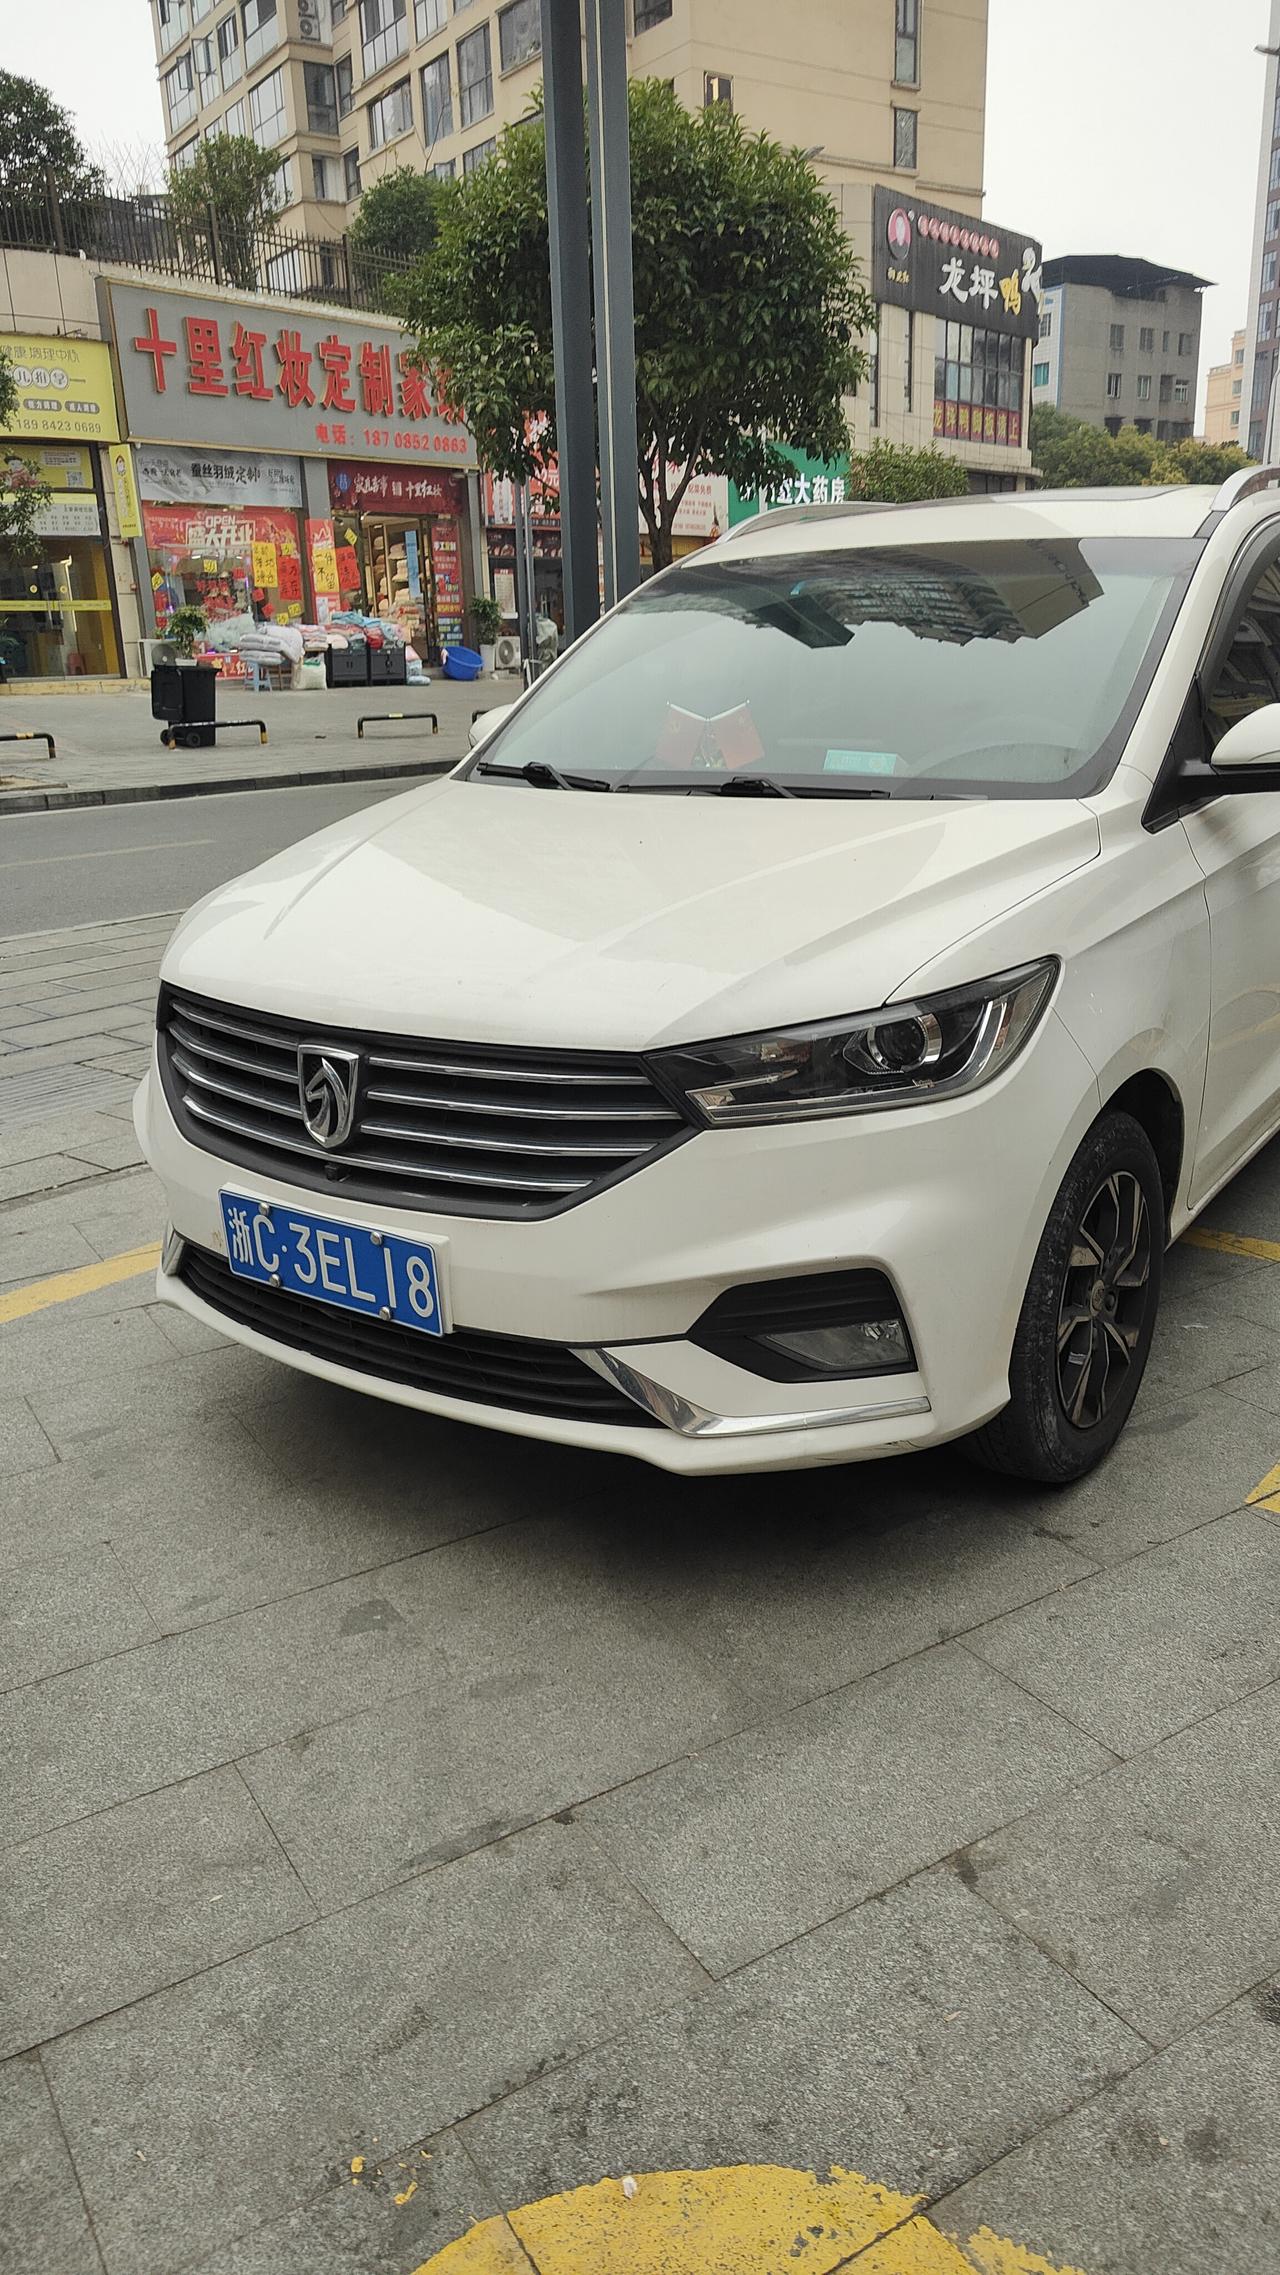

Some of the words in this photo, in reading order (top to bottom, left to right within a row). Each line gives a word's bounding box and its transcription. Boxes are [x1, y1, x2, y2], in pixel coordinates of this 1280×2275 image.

[42, 420, 72, 432] 8423
[74, 422, 102, 433] 0689
[364, 429, 390, 447] 187
[394, 431, 430, 450] 0852
[433, 435, 468, 453] 0863
[205, 515, 236, 528] OPEN
